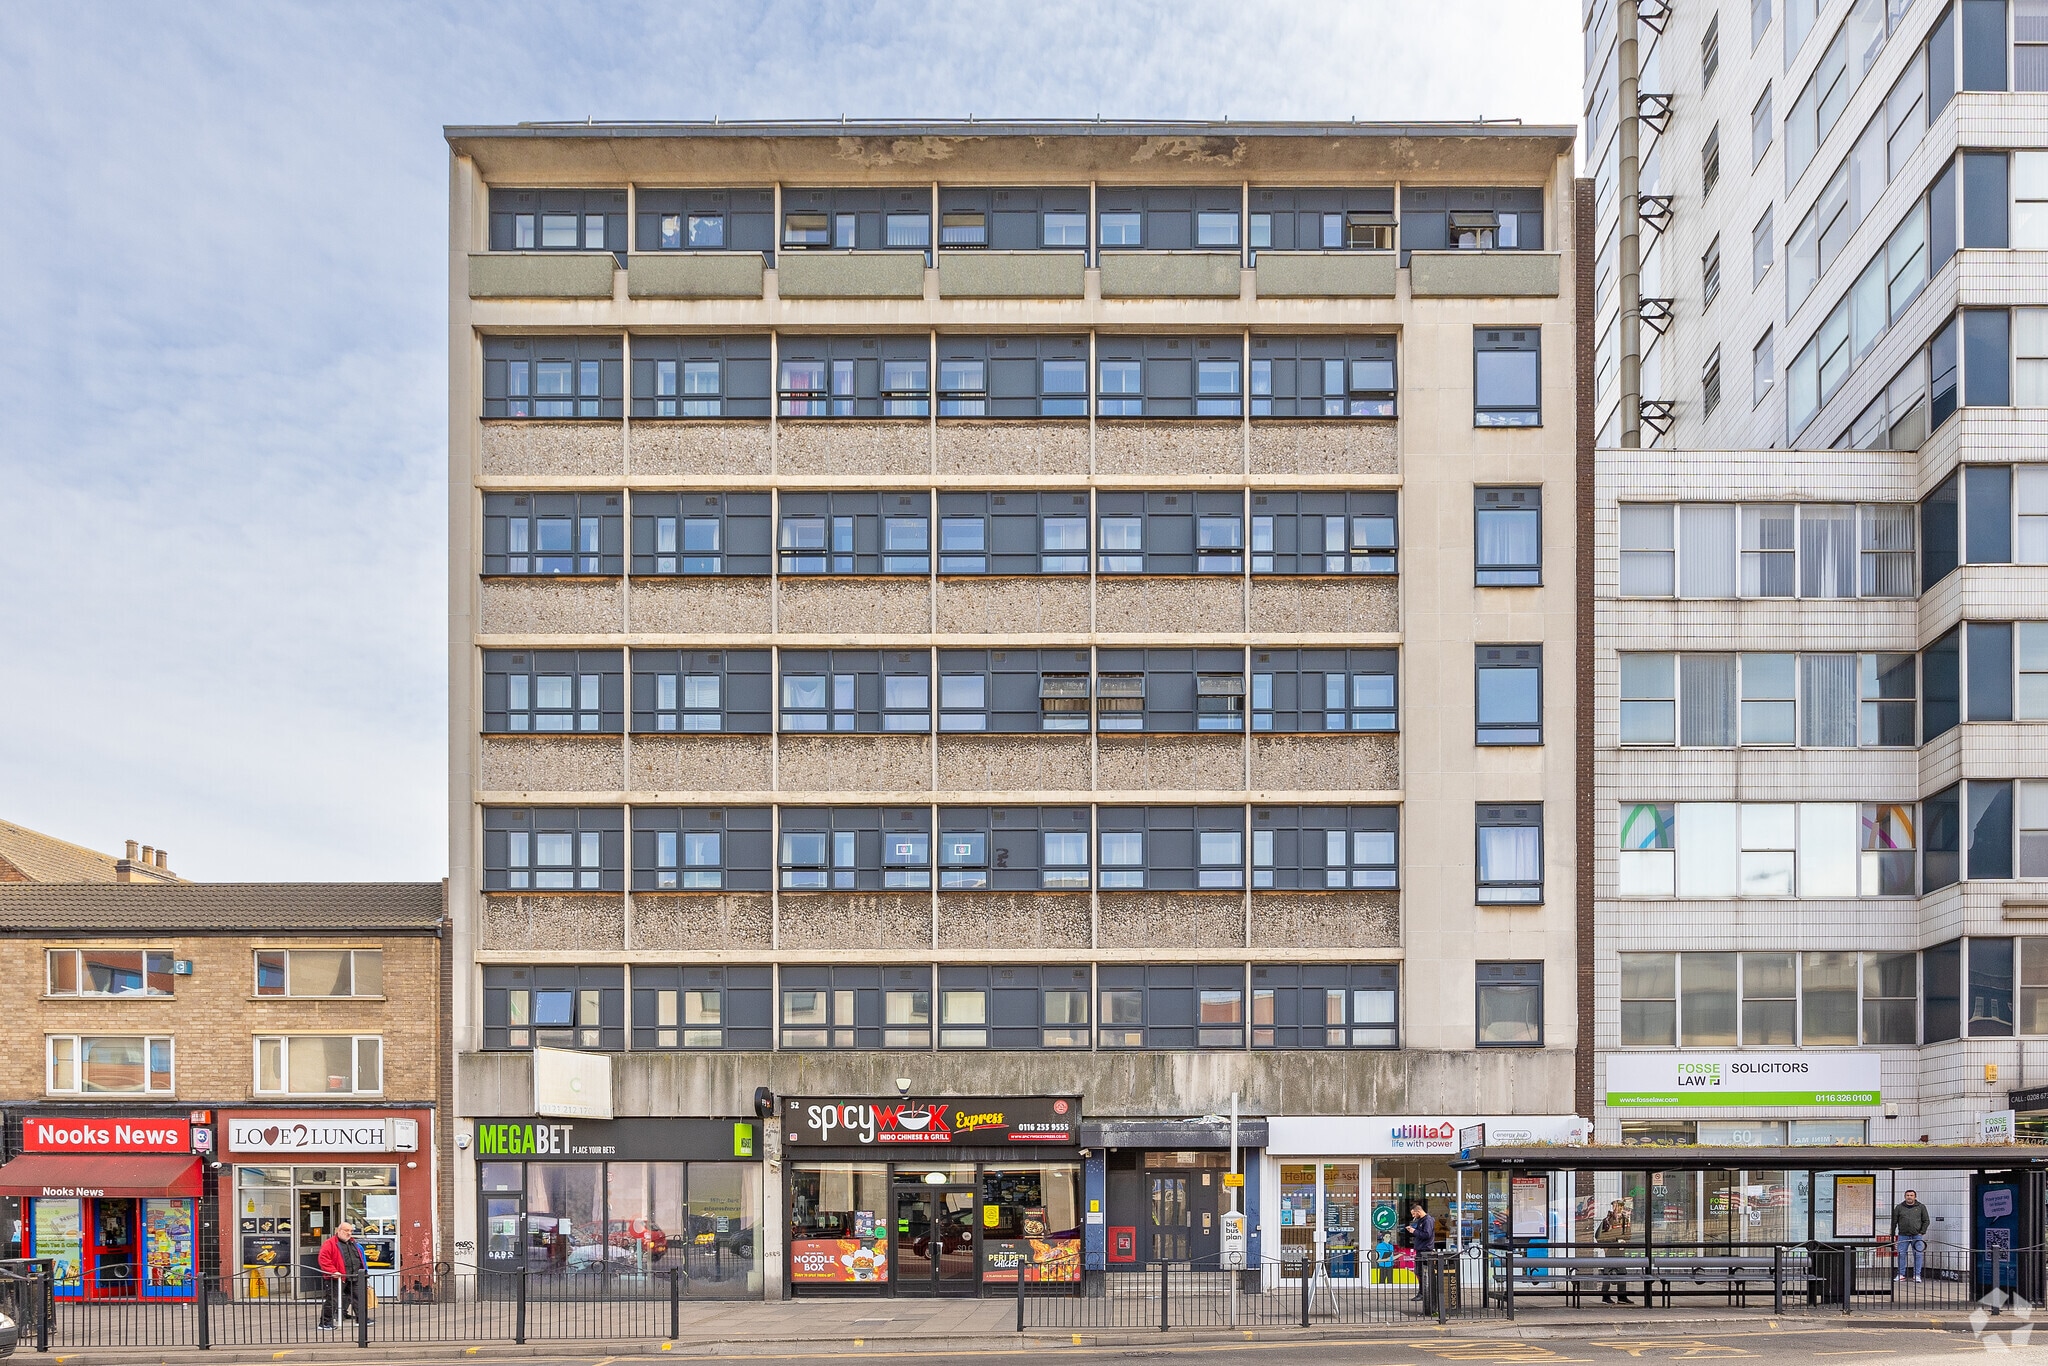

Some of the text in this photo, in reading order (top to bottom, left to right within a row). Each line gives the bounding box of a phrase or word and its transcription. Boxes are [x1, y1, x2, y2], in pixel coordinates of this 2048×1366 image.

[1678, 1063, 1720, 1074] FOSSE
[1731, 1062, 1809, 1074] SOLICITORS
[1678, 1075, 1706, 1086] LAW
[1815, 1094, 1873, 1102] 0116 326 0100
[955, 1111, 1005, 1132] Express
[1985, 1116, 2007, 1125] FOSSE
[1018, 1123, 1034, 1131] 0116
[1051, 1123, 1069, 1131] 9555
[1391, 1124, 1438, 1139] utilita
[38, 1124, 110, 1145] Nooks
[115, 1124, 178, 1145] News
[479, 1124, 574, 1154] MEGABET
[1732, 1130, 1752, 1143] 60
[1391, 1139, 1453, 1148] life with power
[1285, 1172, 1314, 1180] Hello
[42, 1187, 104, 1196] Nooks News
[1225, 1220, 1237, 1228] big
[793, 1255, 835, 1263] NOODLE
[804, 1263, 825, 1271] BOX
